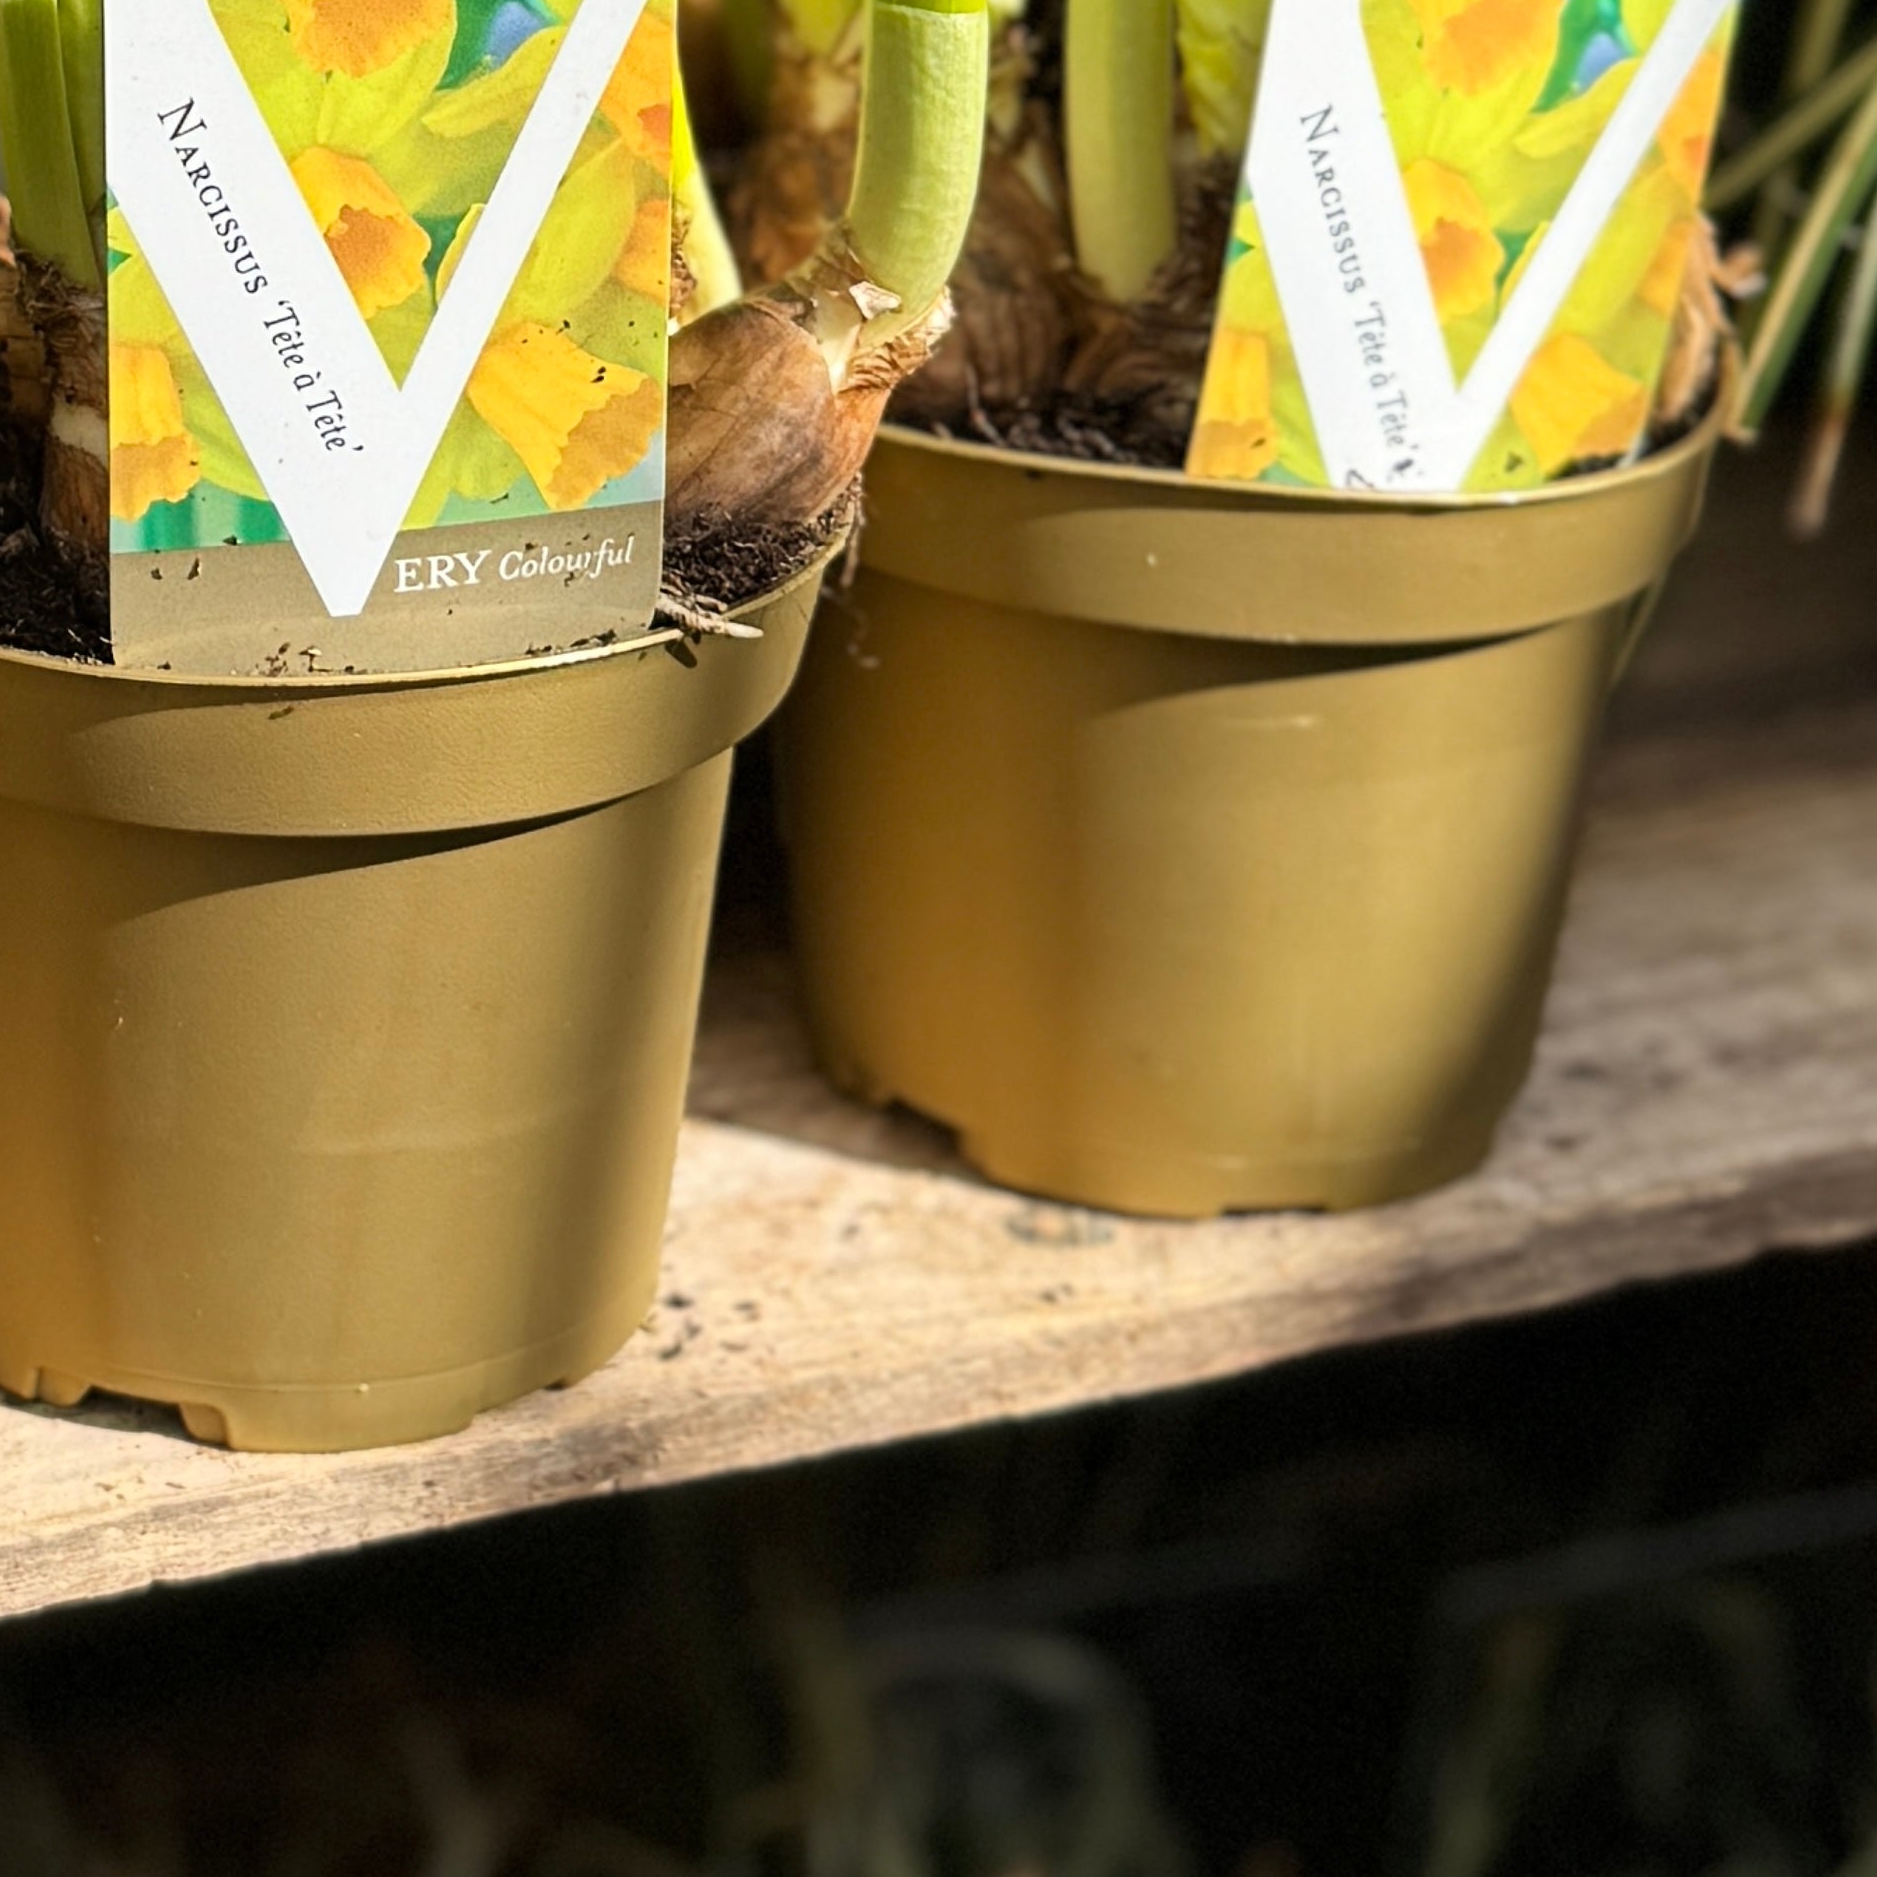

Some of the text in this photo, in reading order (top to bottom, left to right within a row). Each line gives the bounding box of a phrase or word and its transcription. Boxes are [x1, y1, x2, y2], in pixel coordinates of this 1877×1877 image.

[293, 370, 322, 392] à
[1369, 371, 1389, 390] à
[498, 535, 635, 583] Colourful
